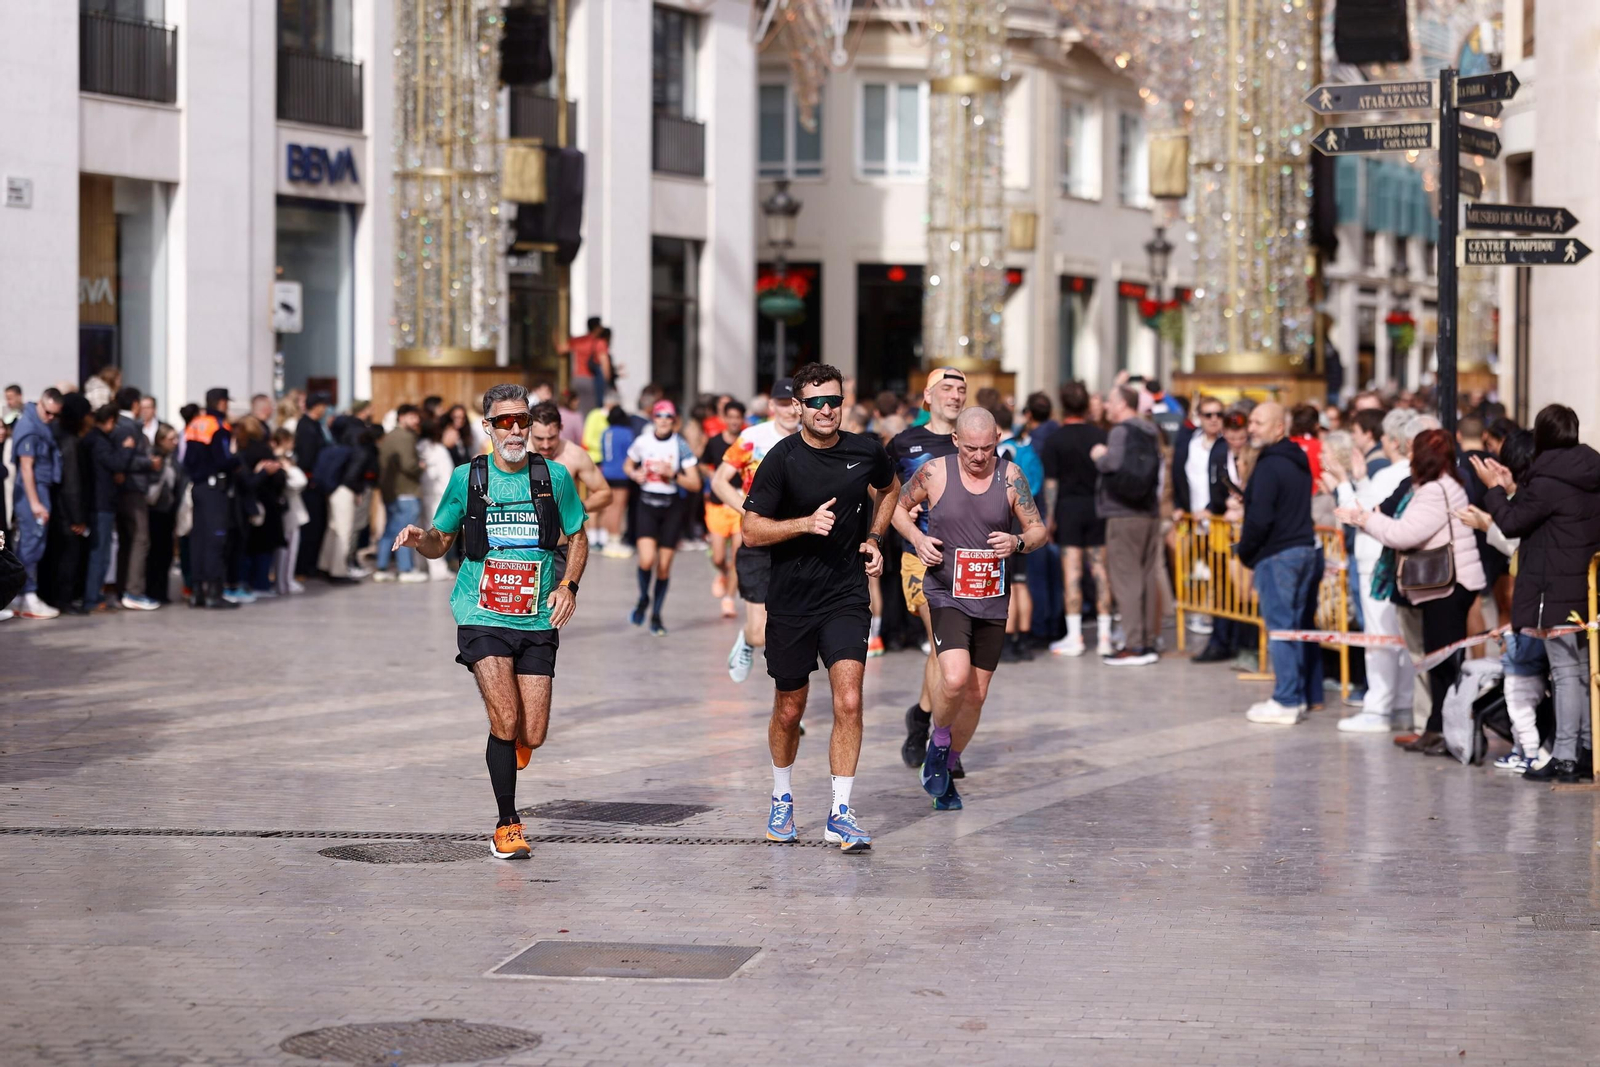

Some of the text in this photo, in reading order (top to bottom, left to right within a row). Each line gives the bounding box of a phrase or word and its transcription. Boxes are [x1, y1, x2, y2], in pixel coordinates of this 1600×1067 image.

[1358, 92, 1429, 109] ATARAZANAS
[1363, 124, 1428, 140] TEATRO SOHO
[286, 143, 359, 187] BBVA
[1466, 208, 1552, 228] MUSEO DE MÁLAGA
[1468, 240, 1556, 252] CENTRE POMPIDOU
[495, 561, 532, 571] GENERALI
[968, 562, 994, 572] 3675
[494, 573, 522, 585] 9482
